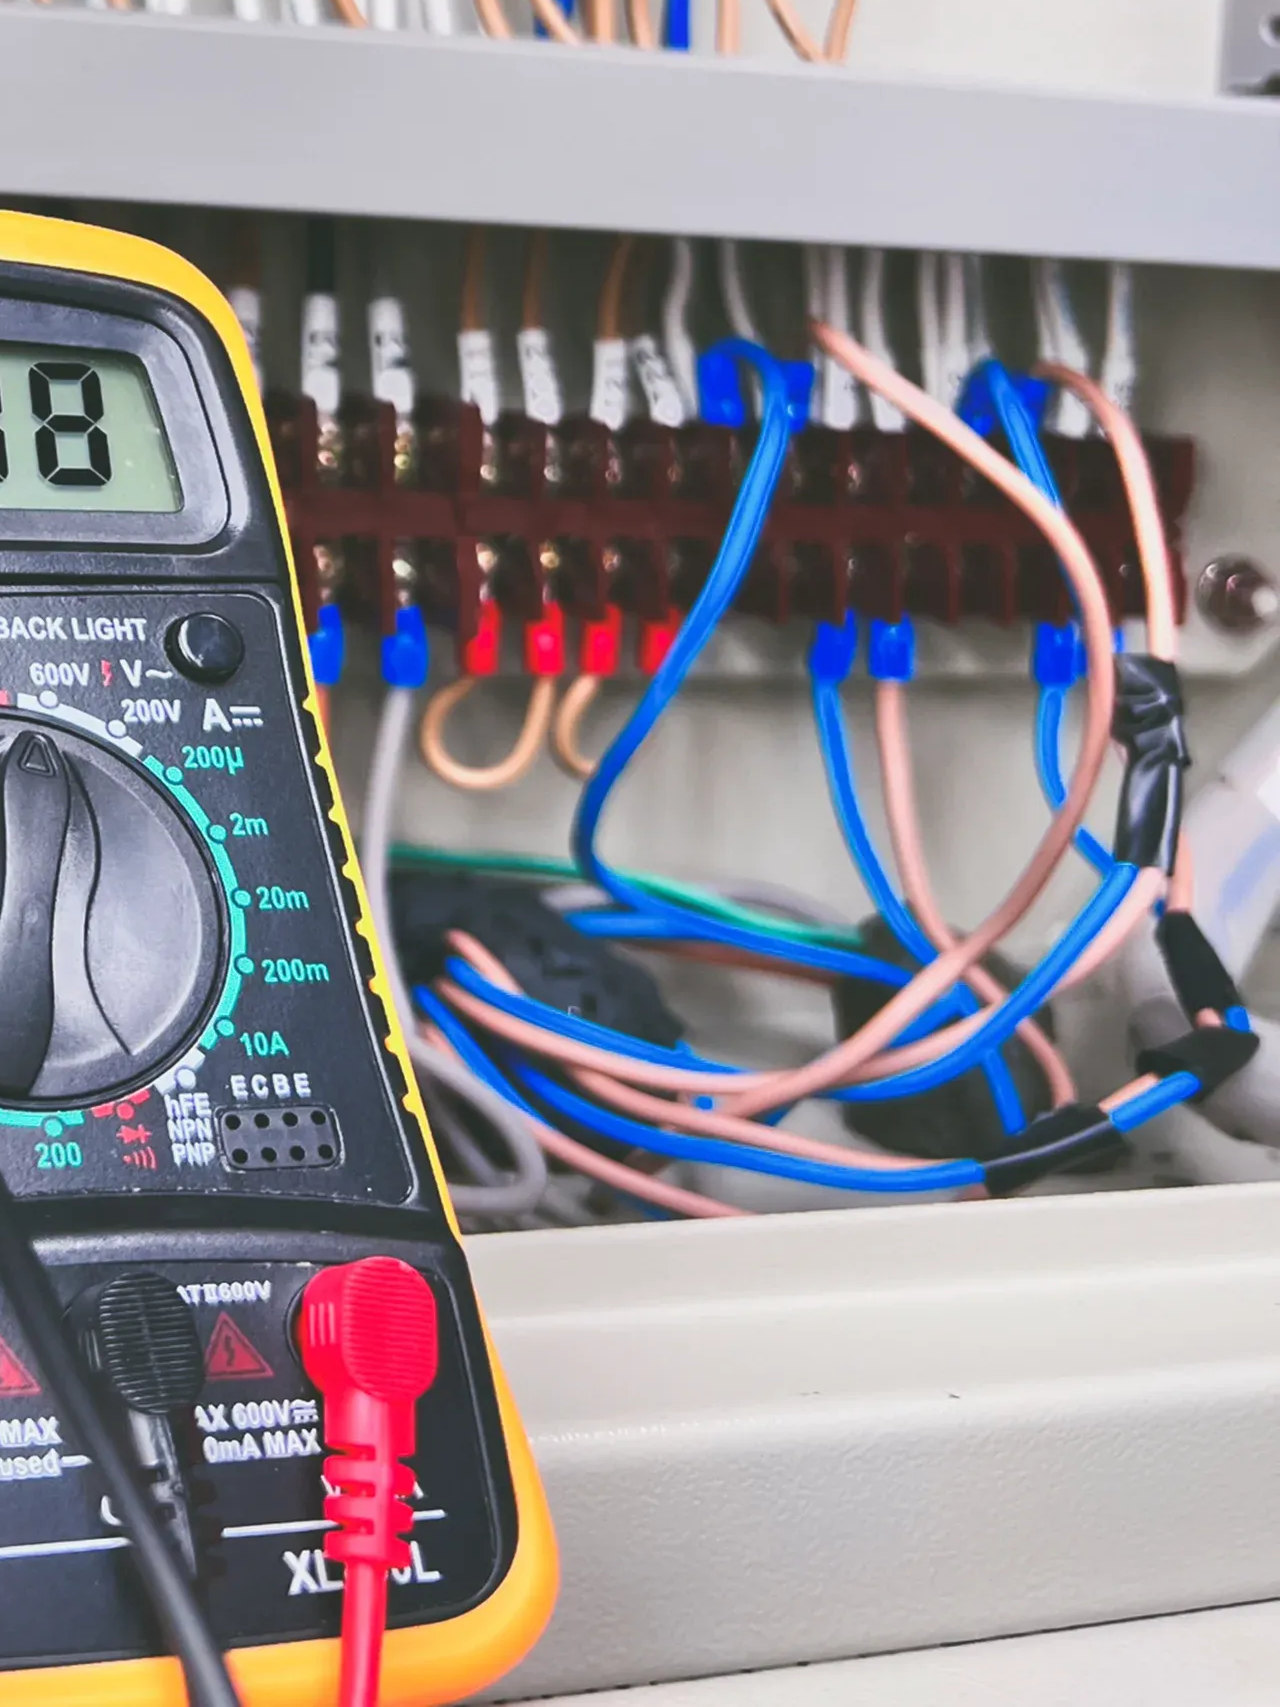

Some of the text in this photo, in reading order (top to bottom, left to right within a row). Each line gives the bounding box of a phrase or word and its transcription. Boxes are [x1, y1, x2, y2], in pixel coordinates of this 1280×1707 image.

[72, 618, 147, 642] LIGHT
[29, 662, 90, 687] 600V
[122, 698, 181, 724] 200V
[229, 813, 269, 837] 2m
[256, 886, 309, 911] 20m
[262, 958, 330, 983] 200m
[240, 1031, 290, 1058] 10A
[163, 1092, 212, 1119] hFE
[166, 1118, 213, 1143] NPN
[35, 1142, 83, 1169] 200
[171, 1142, 216, 1167] PNP
[203, 1428, 321, 1463] 0mA MAX
